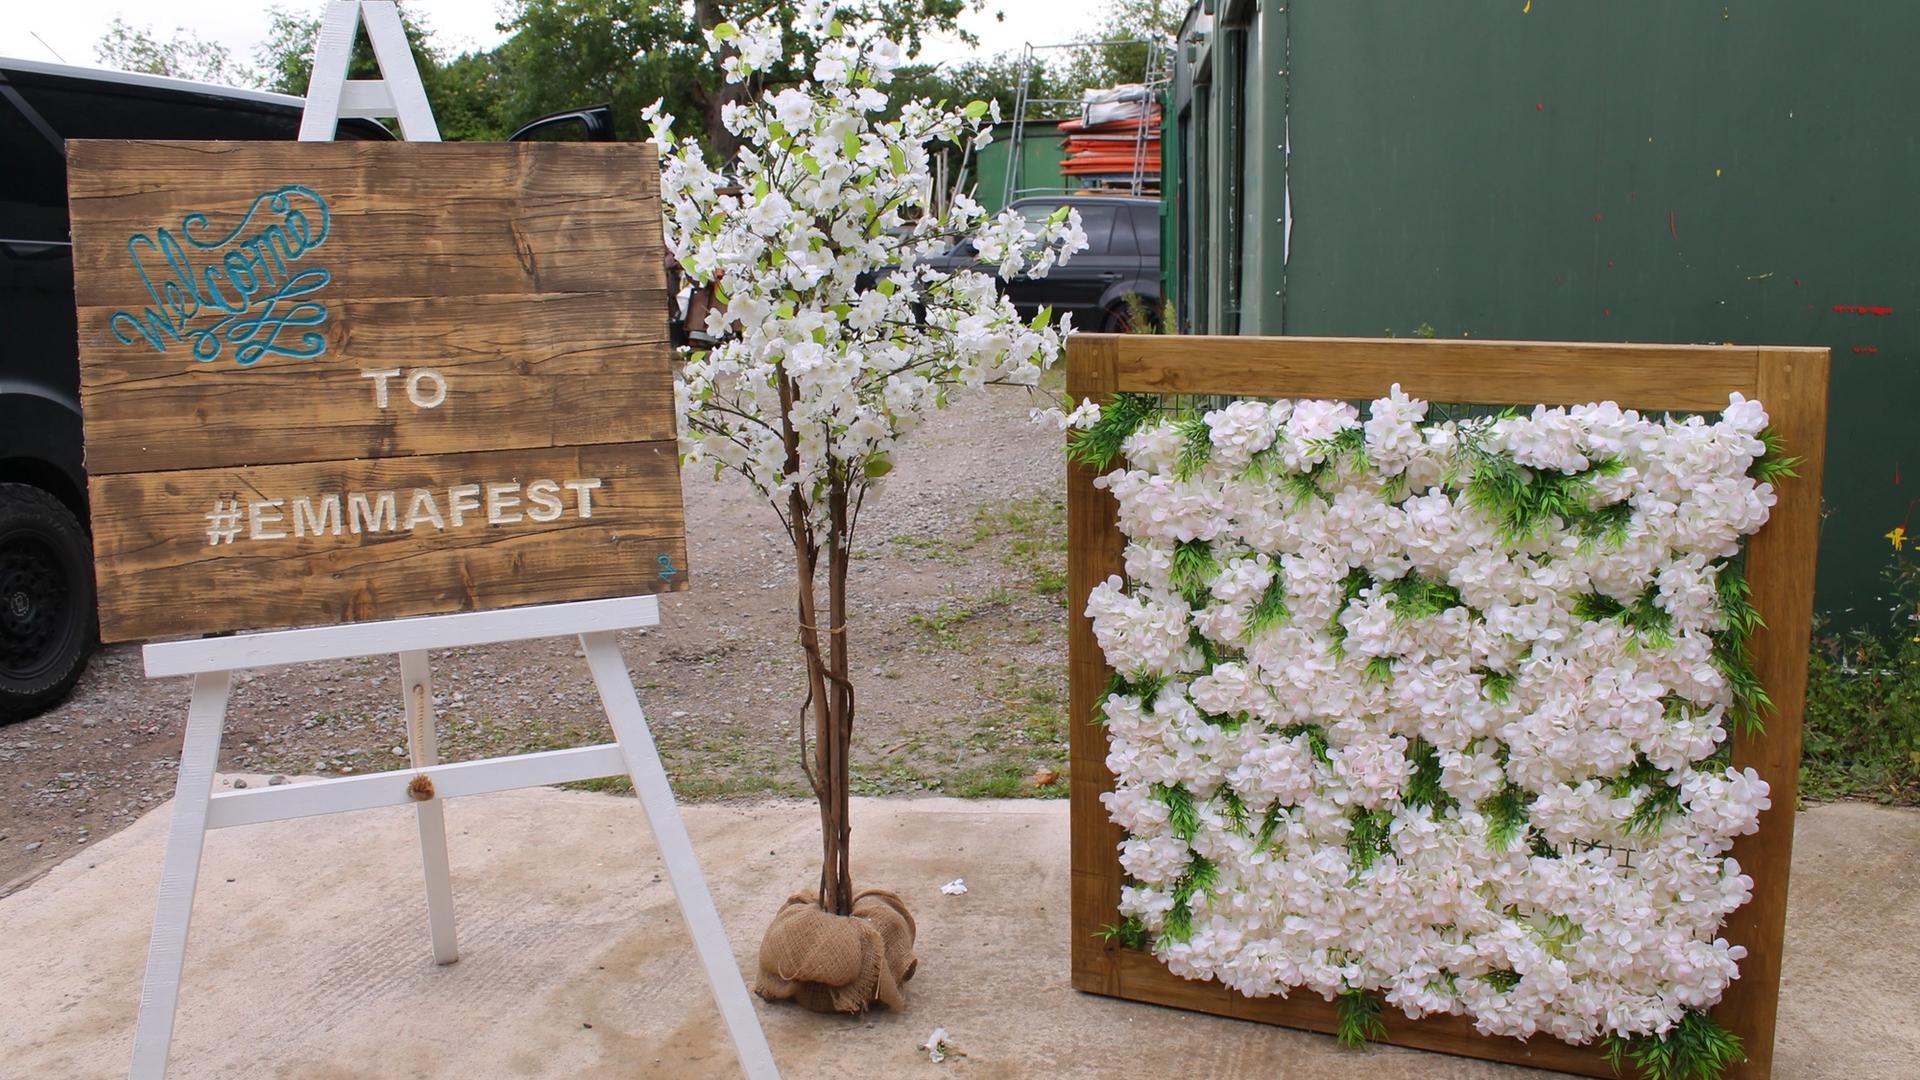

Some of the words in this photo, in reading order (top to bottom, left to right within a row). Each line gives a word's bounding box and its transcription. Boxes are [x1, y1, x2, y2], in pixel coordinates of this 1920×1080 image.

[110, 184, 331, 365] Welcome
[362, 368, 447, 409] TO
[205, 478, 601, 545] #EMMAFEST
